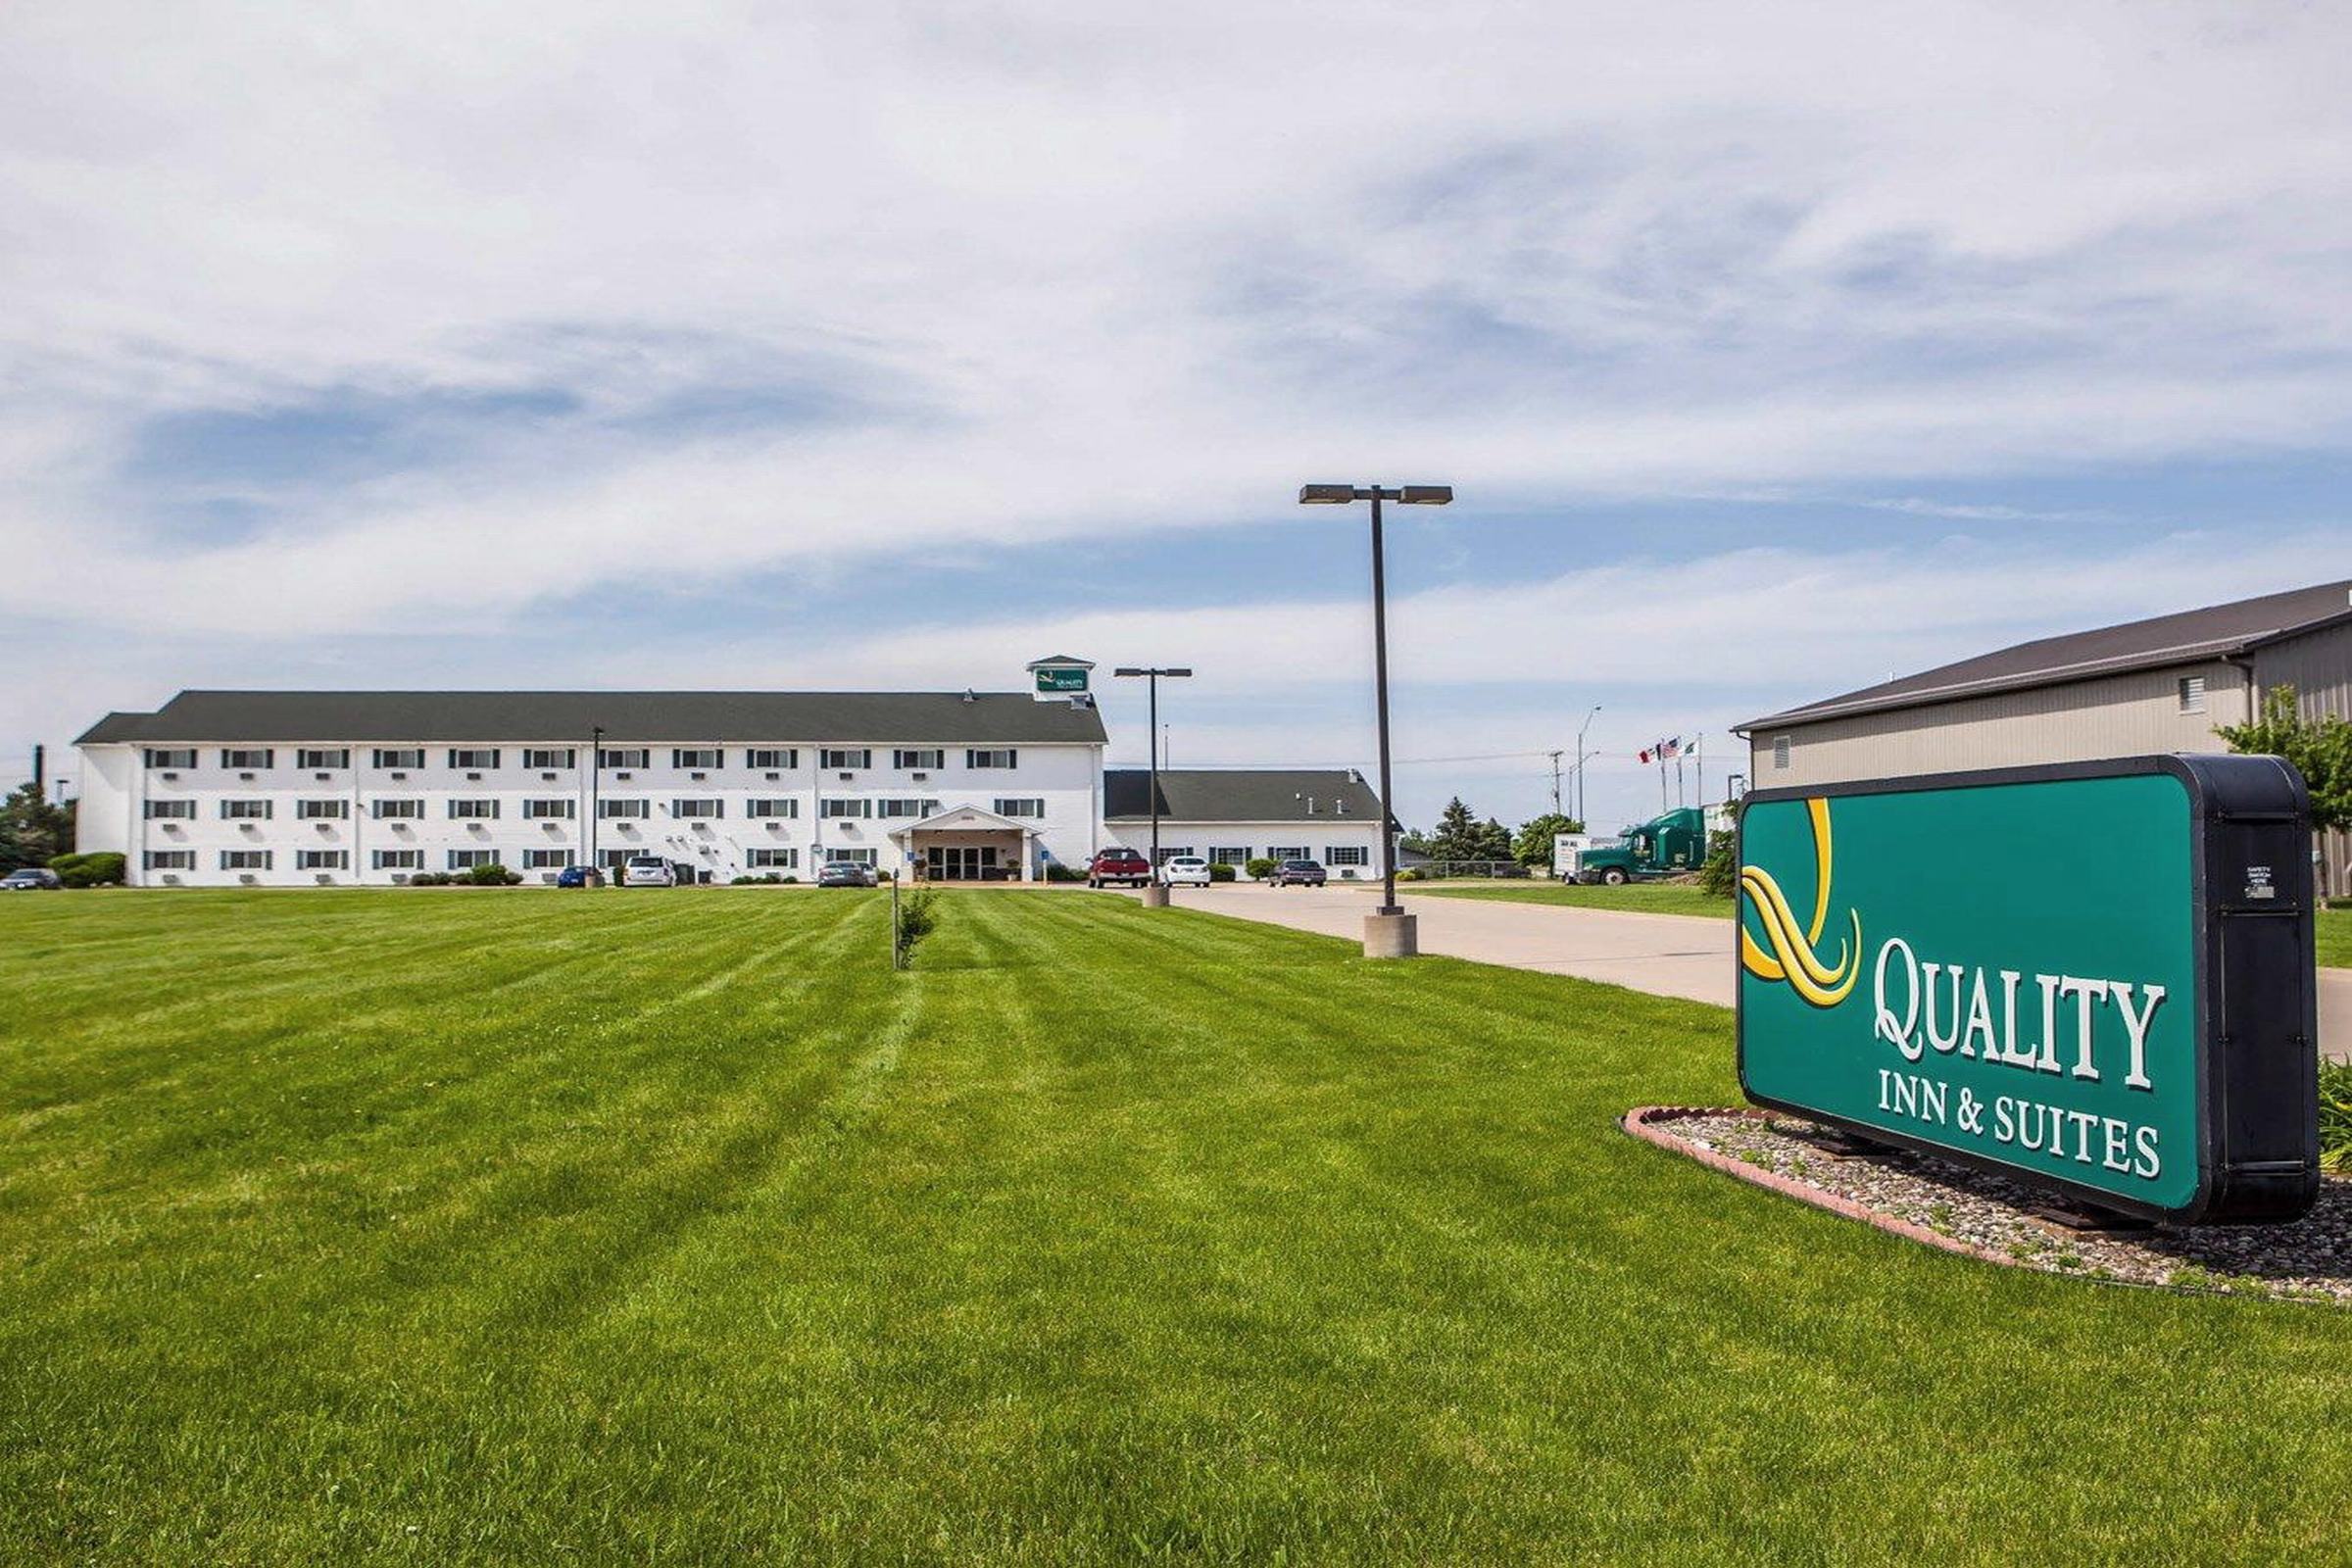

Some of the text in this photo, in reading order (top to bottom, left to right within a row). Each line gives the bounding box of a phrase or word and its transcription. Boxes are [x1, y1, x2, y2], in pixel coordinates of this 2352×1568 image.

[1874, 938, 2166, 1090] QUALITY
[1879, 1068, 2160, 1177] INN & SUITES
